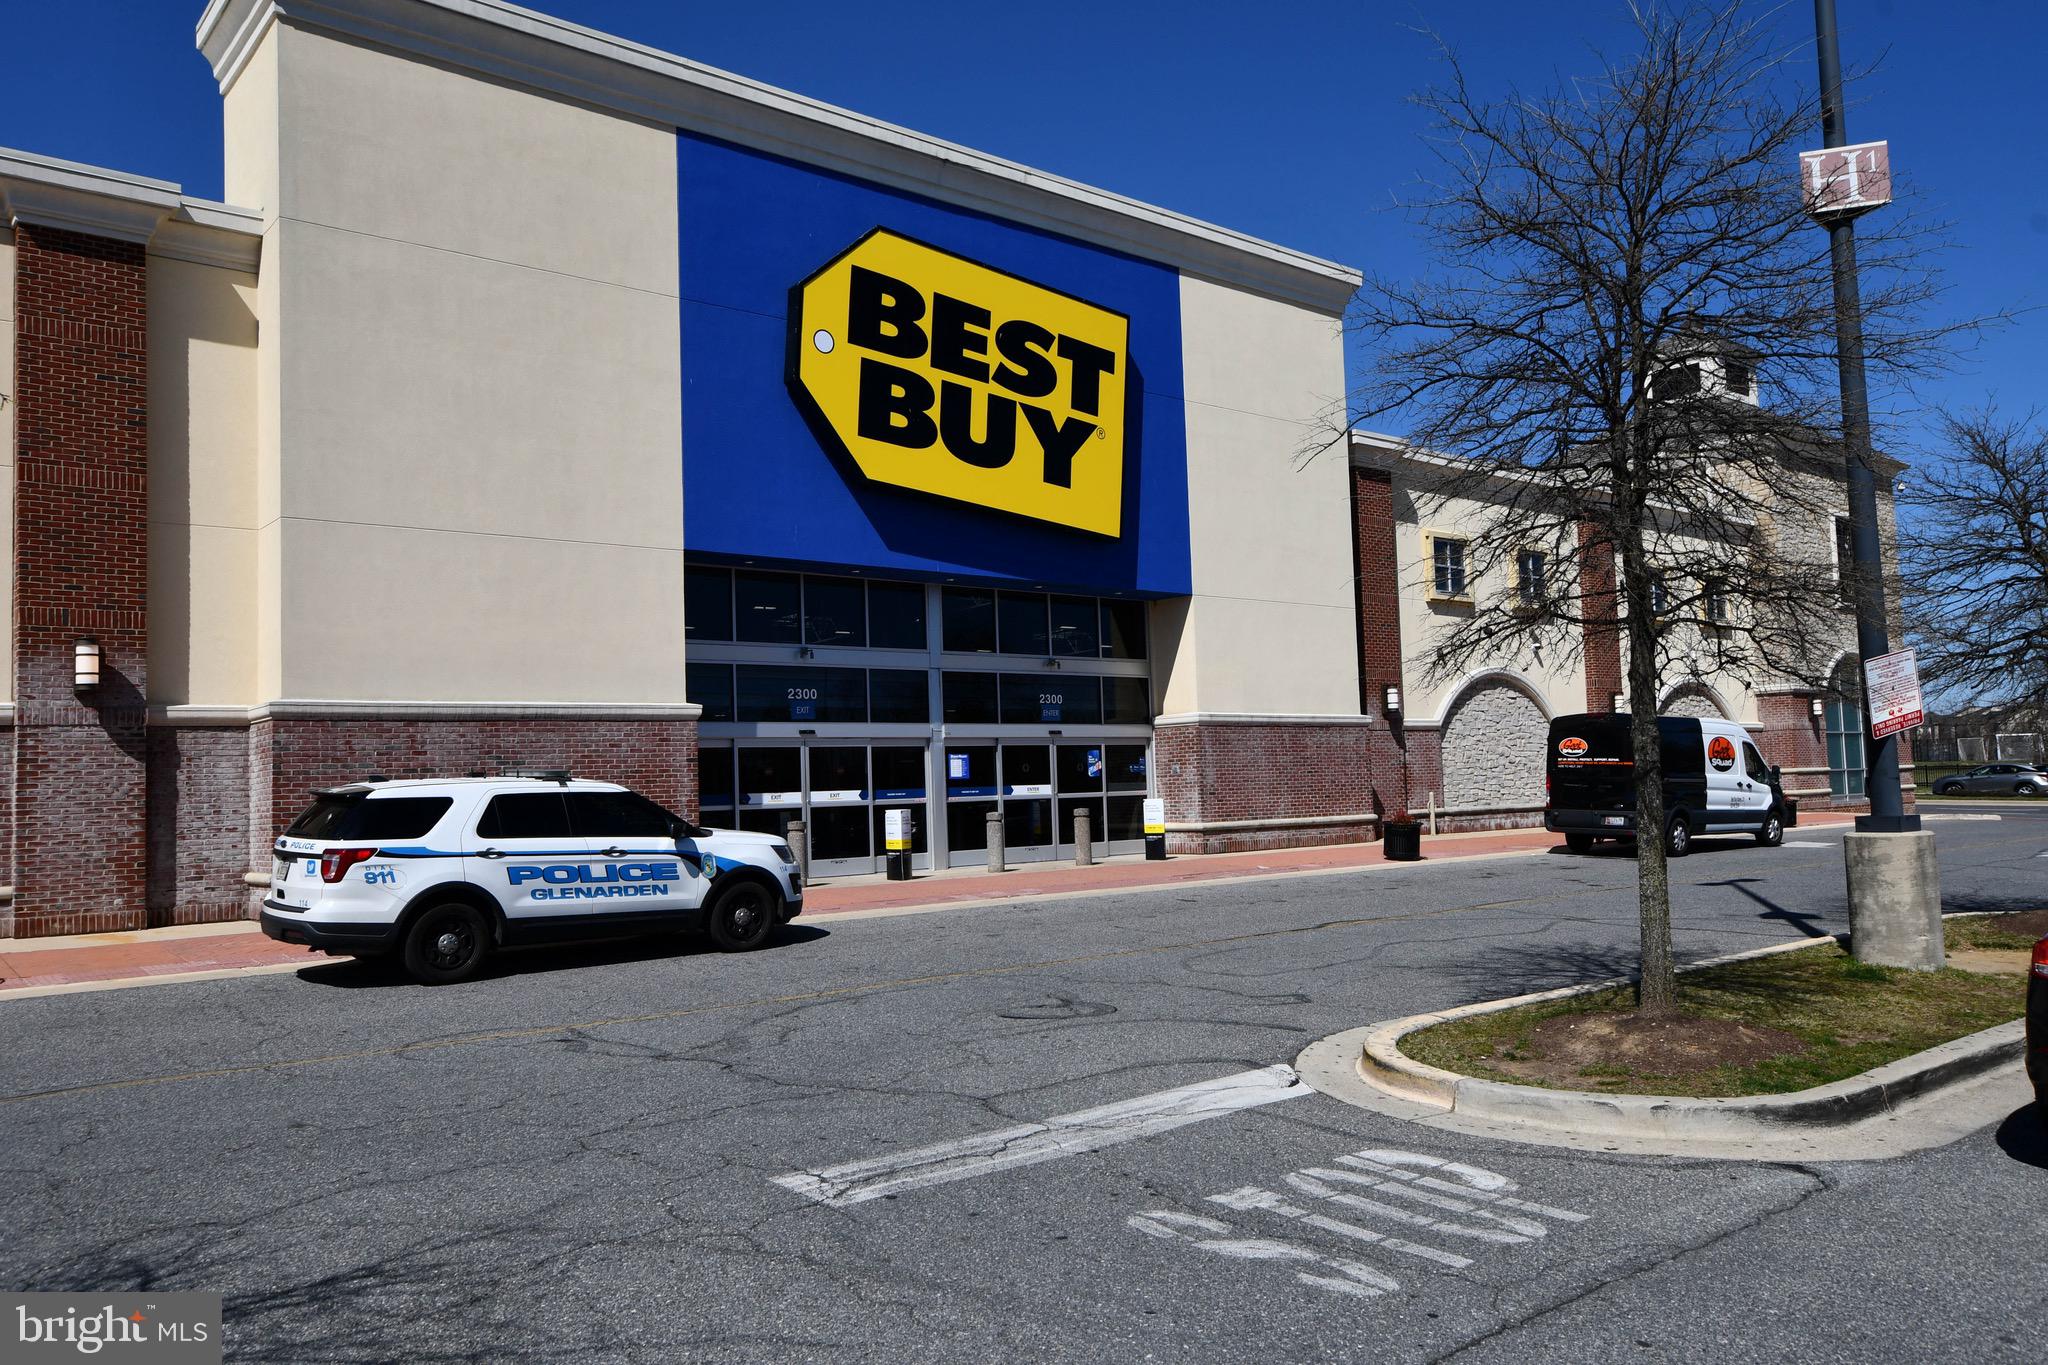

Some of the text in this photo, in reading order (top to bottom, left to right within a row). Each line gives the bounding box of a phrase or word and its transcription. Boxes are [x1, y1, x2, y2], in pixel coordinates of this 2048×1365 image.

[848, 264, 1116, 417] BEST
[858, 357, 1098, 489] BUY
[787, 688, 818, 700] 2300
[1039, 693, 1063, 704] 2300
[796, 706, 809, 714] EXIT
[1042, 709, 1060, 717] ENTER
[290, 841, 316, 850] POLICE
[364, 870, 396, 884] 911
[506, 863, 680, 885] POLICE
[530, 884, 669, 900] GLENARDEN
[299, 899, 308, 907] 114
[1127, 1148, 1590, 1297] STOP
